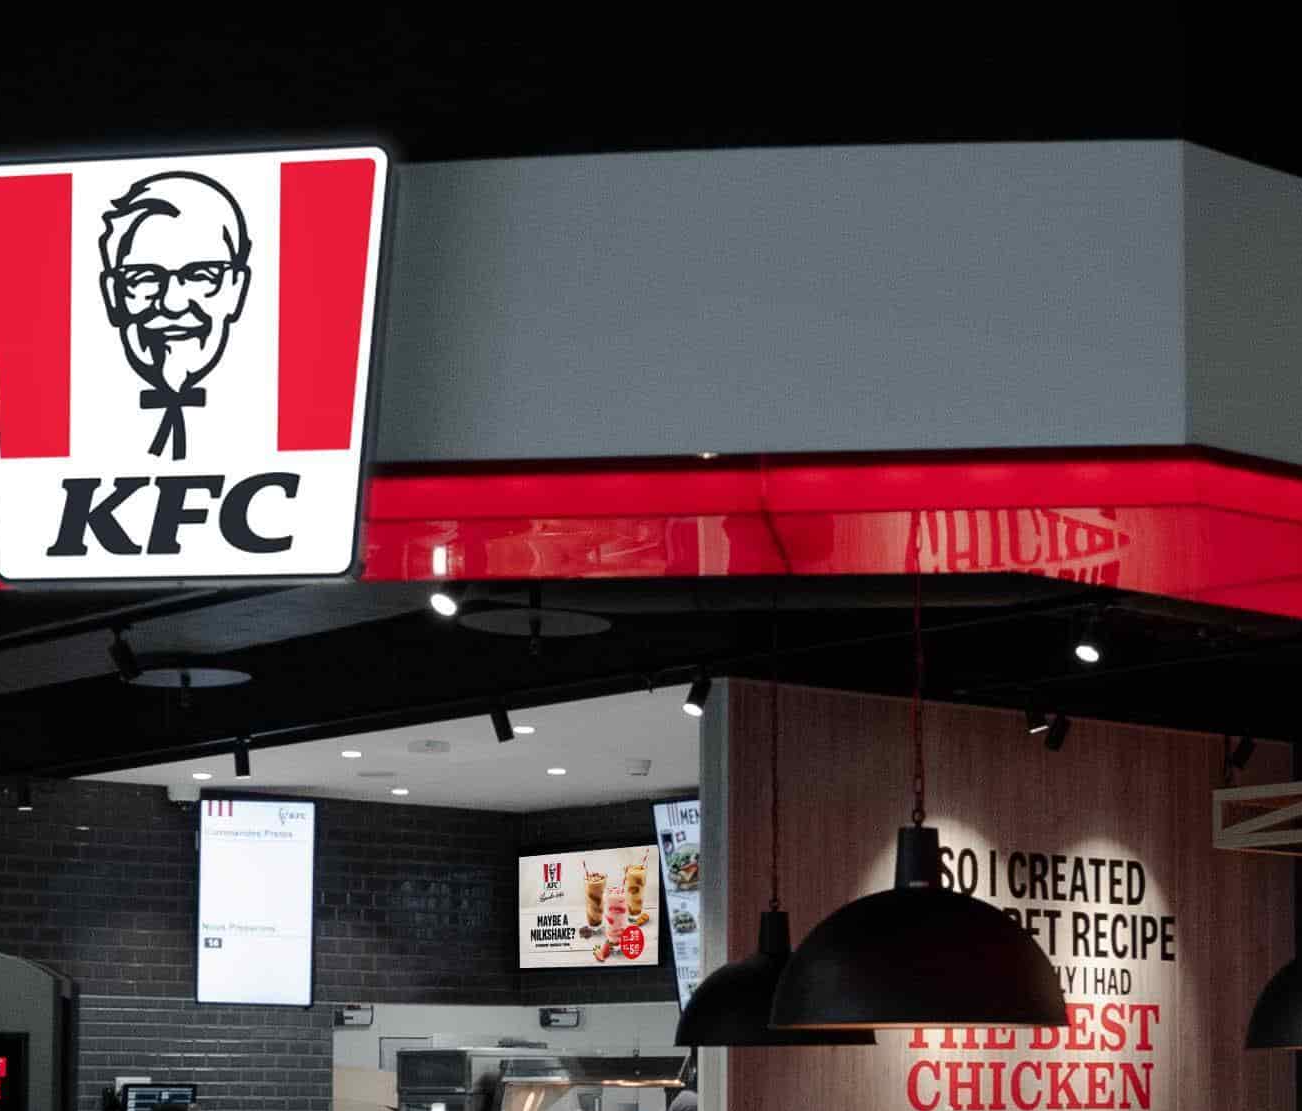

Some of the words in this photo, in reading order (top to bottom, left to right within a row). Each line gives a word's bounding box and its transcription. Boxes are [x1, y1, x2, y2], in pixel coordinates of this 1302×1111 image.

[46, 472, 301, 557] KFC
[938, 846, 978, 896] SO
[989, 850, 997, 897] I
[1008, 851, 1146, 906] CREATED
[531, 927, 575, 941] MILKSHAKE?
[537, 914, 561, 928] MAYBE
[563, 913, 568, 925] A
[1073, 911, 1176, 961] RECIPE
[1083, 966, 1088, 994] I
[1094, 967, 1132, 995] HAD
[907, 1060, 1154, 1111] CHICKEN
